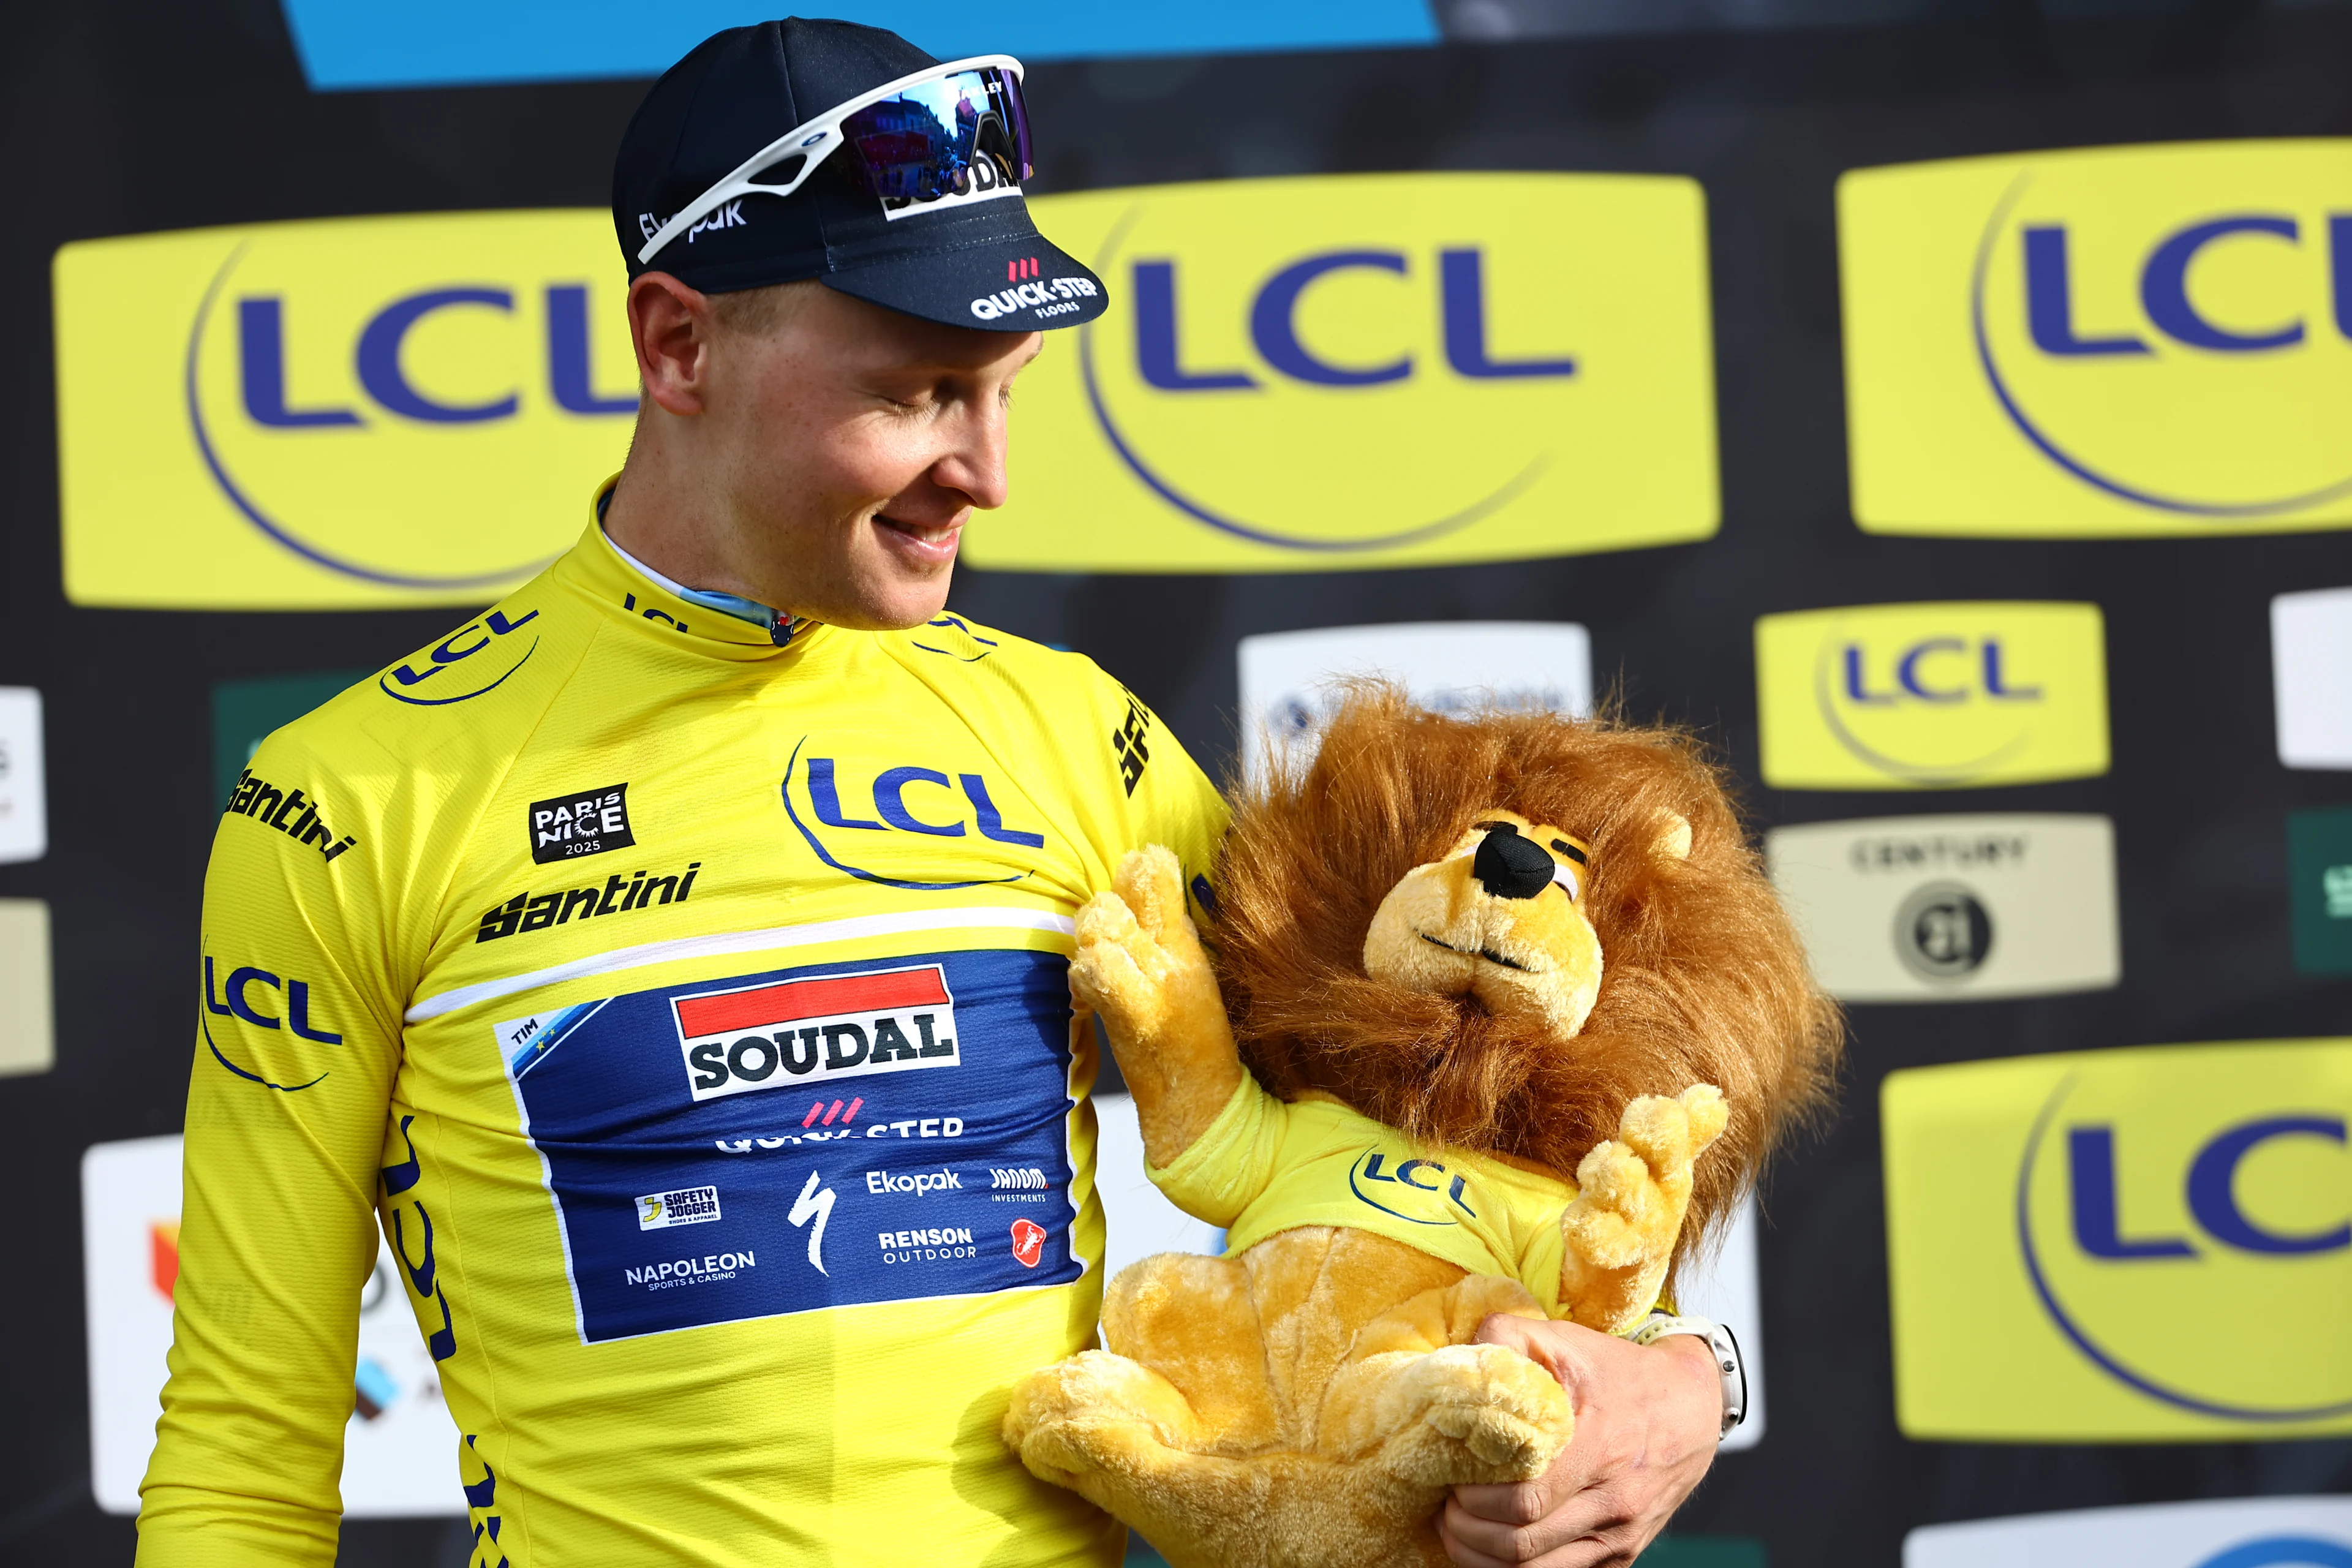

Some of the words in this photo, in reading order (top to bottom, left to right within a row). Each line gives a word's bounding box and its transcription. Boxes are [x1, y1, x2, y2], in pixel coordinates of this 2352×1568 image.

[2020, 208, 2352, 359] LC
[1035, 301, 1080, 319] FLOORS
[1127, 242, 1579, 396] LCL
[234, 278, 641, 431] LCL
[391, 609, 540, 686] LCL
[1844, 635, 2043, 706] LCL
[534, 791, 621, 830] PARIS
[806, 758, 1044, 850] LCL
[538, 805, 625, 850] NICE
[565, 840, 601, 856] 2025
[475, 862, 702, 944] Santini
[204, 956, 342, 1046] LCL
[511, 1017, 538, 1045] TIM
[689, 1014, 955, 1090] SOUDAL
[664, 1188, 714, 1207] SAFETY
[865, 1168, 963, 1196] Ekopak
[992, 1194, 1046, 1203] INVESTMENTS
[1363, 1153, 1477, 1219] LCL
[667, 1200, 717, 1219] JOGGER
[669, 1216, 687, 1225] SHOES
[381, 1115, 457, 1362] LCL
[878, 1227, 974, 1250] RENSON
[883, 1246, 977, 1265] OUTDOOR
[624, 1250, 756, 1286] NAPOLEON
[647, 1278, 687, 1292] SPORTS
[696, 1271, 736, 1283] CASINO
